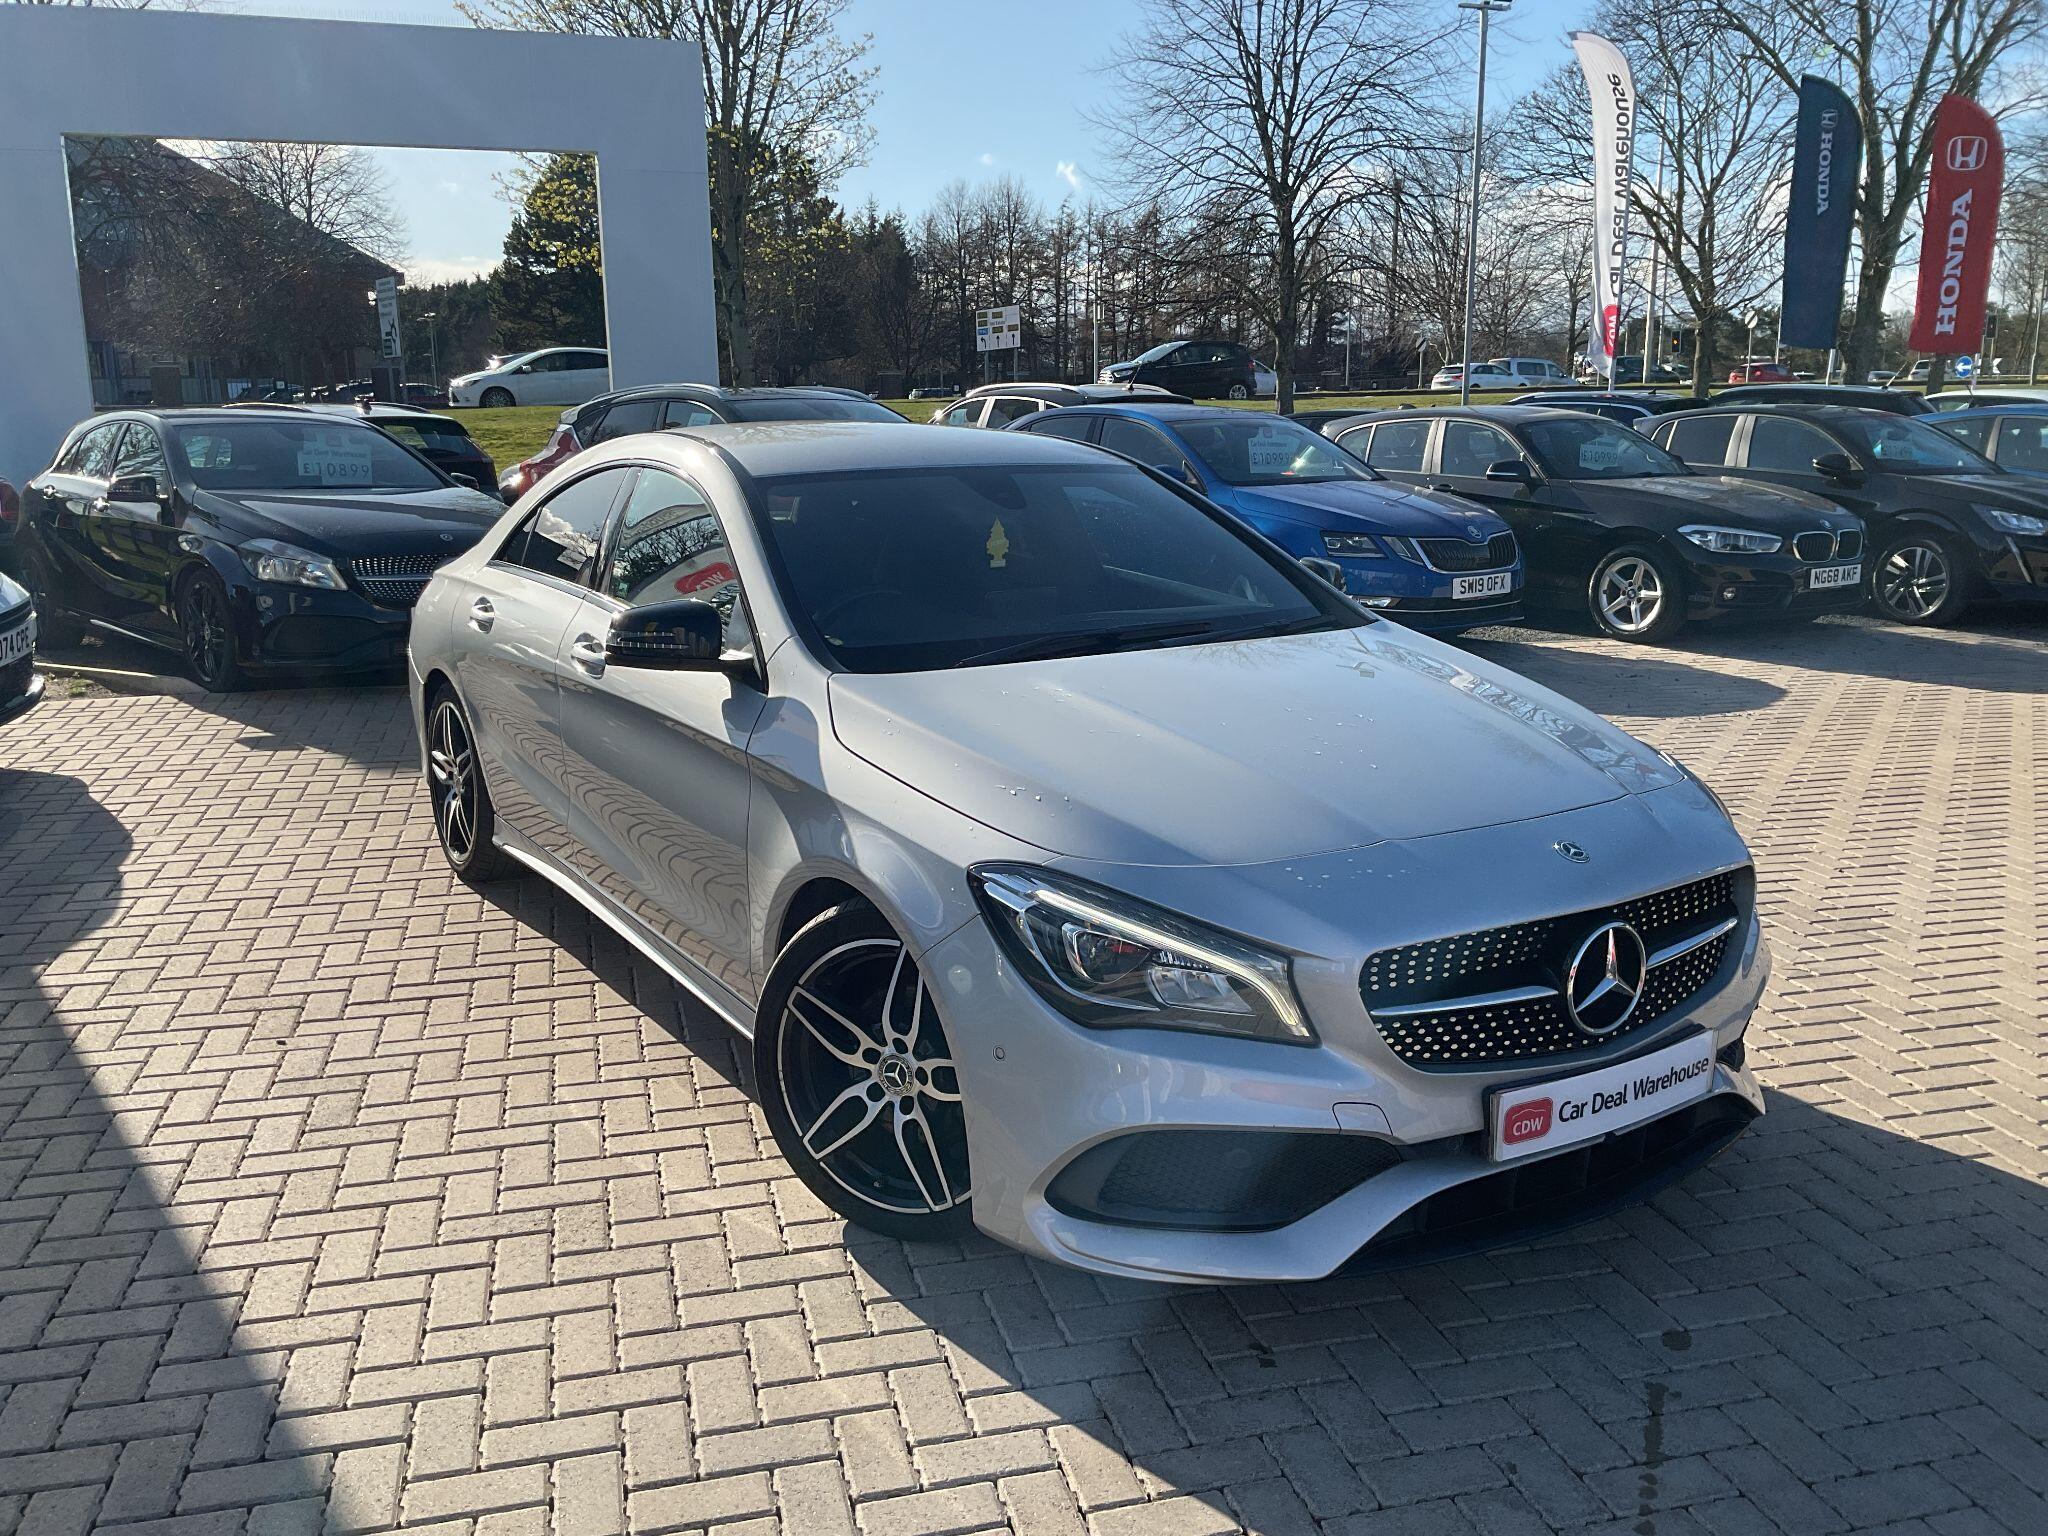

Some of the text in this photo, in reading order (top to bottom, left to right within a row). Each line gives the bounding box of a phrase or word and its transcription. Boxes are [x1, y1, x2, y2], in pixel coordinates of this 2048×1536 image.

[1817, 132, 1833, 216] HONDA
[1935, 188, 1973, 336] HONDA
[303, 462, 369, 478] £10899
[1460, 575, 1506, 594] SW19 OFX
[1814, 567, 1858, 585] NG68 AKF
[16, 626, 30, 653] CPE
[1558, 1057, 1709, 1122] Car Deal Warehouse
[1512, 1117, 1544, 1136] CDW
